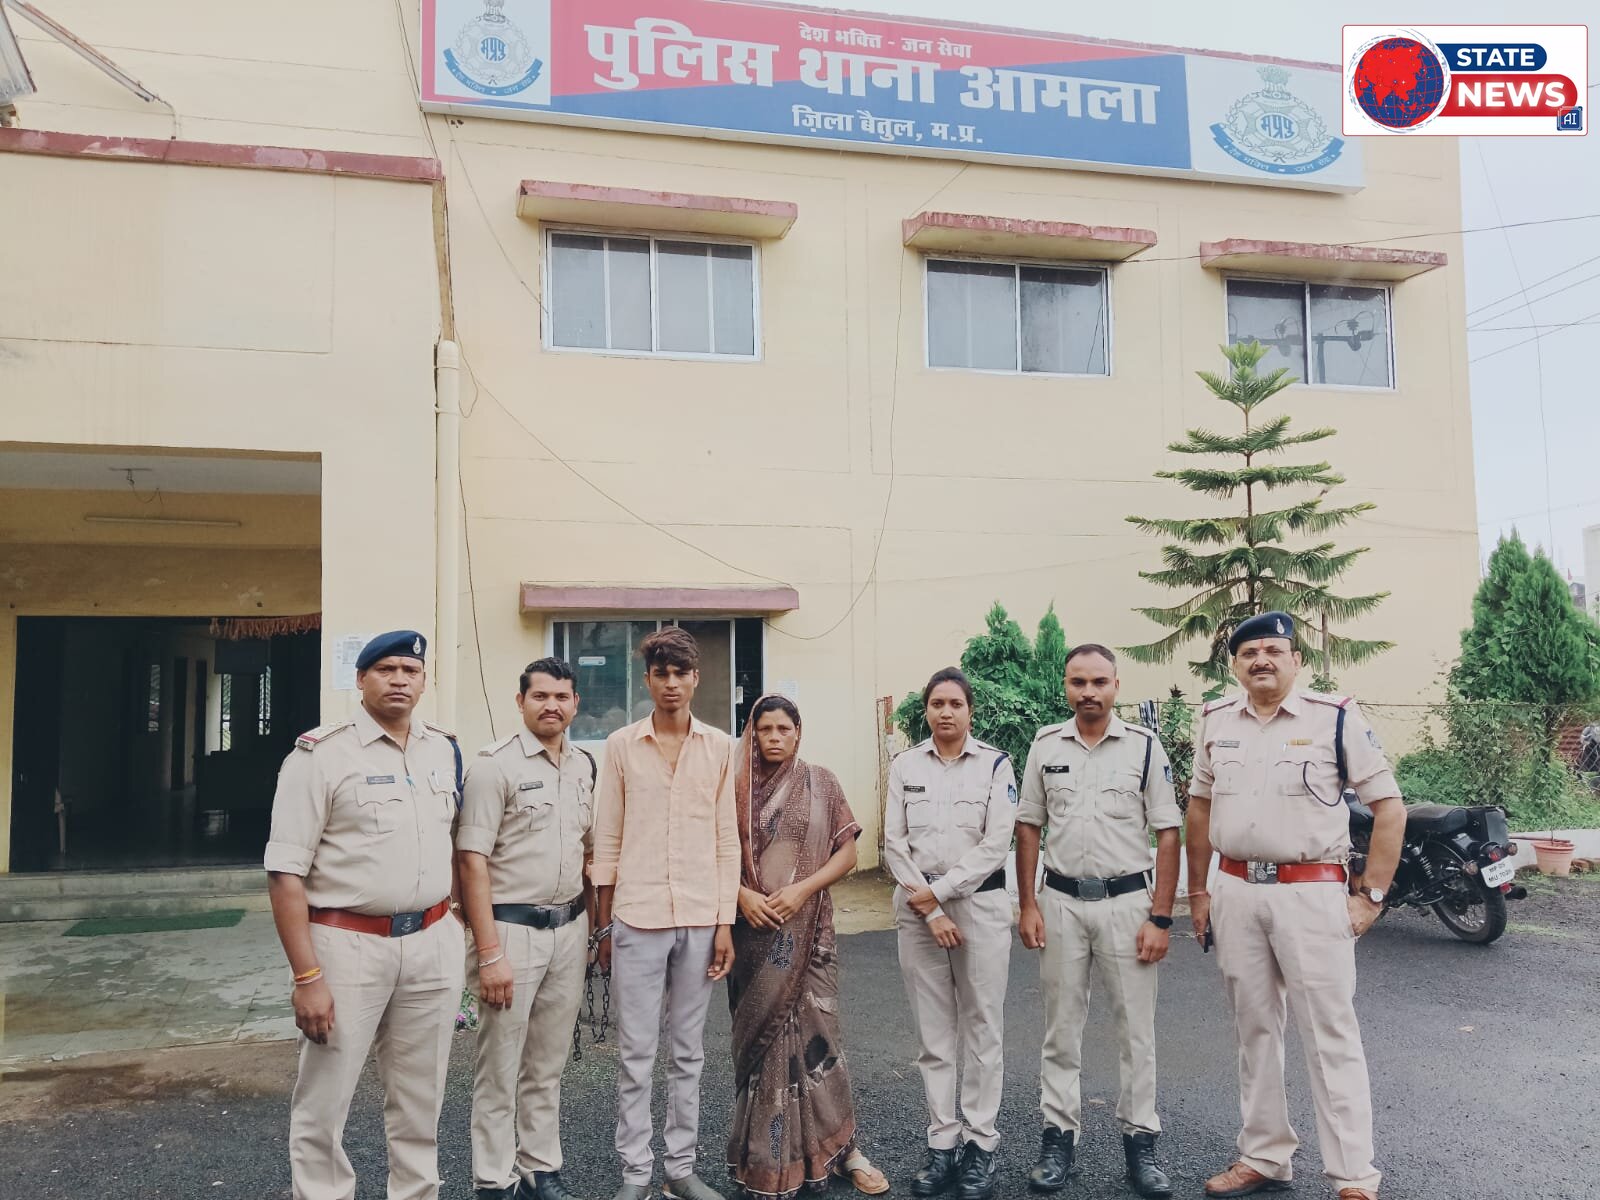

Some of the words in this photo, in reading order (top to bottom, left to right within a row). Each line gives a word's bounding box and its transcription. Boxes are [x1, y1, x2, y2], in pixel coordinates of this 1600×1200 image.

[798, 22, 830, 43] देश
[835, 28, 883, 49] भक्ति
[901, 37, 934, 54] जन
[937, 38, 973, 59] सेवा
[583, 16, 780, 91] पुलिस
[798, 47, 941, 104] थाना
[959, 65, 1161, 125] आमला
[856, 109, 924, 142] बैतुल,
